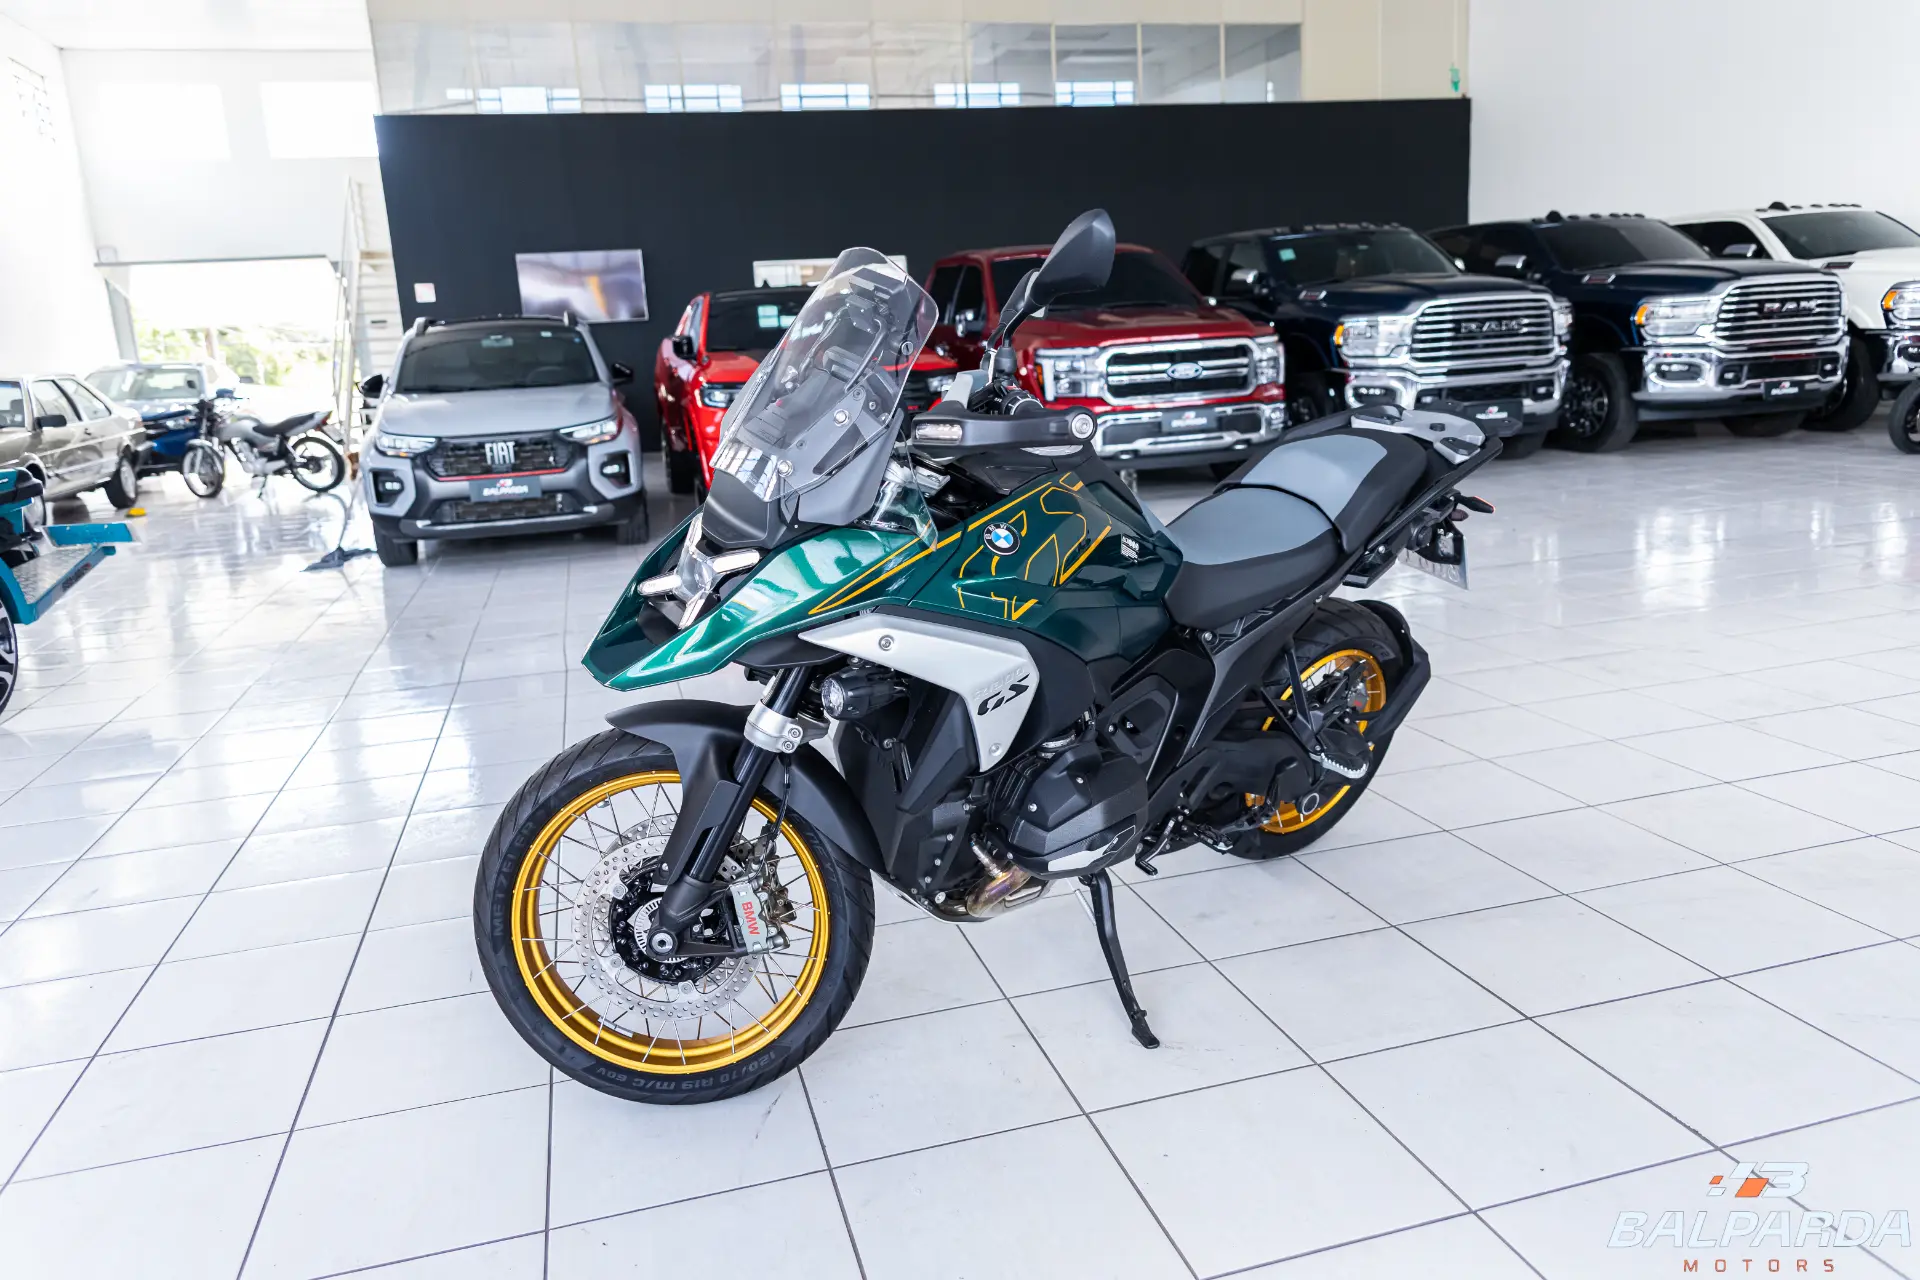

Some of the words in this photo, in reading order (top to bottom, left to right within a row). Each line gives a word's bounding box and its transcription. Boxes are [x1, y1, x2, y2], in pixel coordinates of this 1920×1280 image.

[1763, 300, 1818, 312] RAM
[1461, 320, 1522, 333] RAM
[484, 441, 515, 465] FIAT
[977, 673, 1031, 716] GS
[742, 901, 761, 935] BMW
[596, 1066, 628, 1082] 60V
[719, 1051, 776, 1083] 120/70
[681, 1077, 714, 1090] R19
